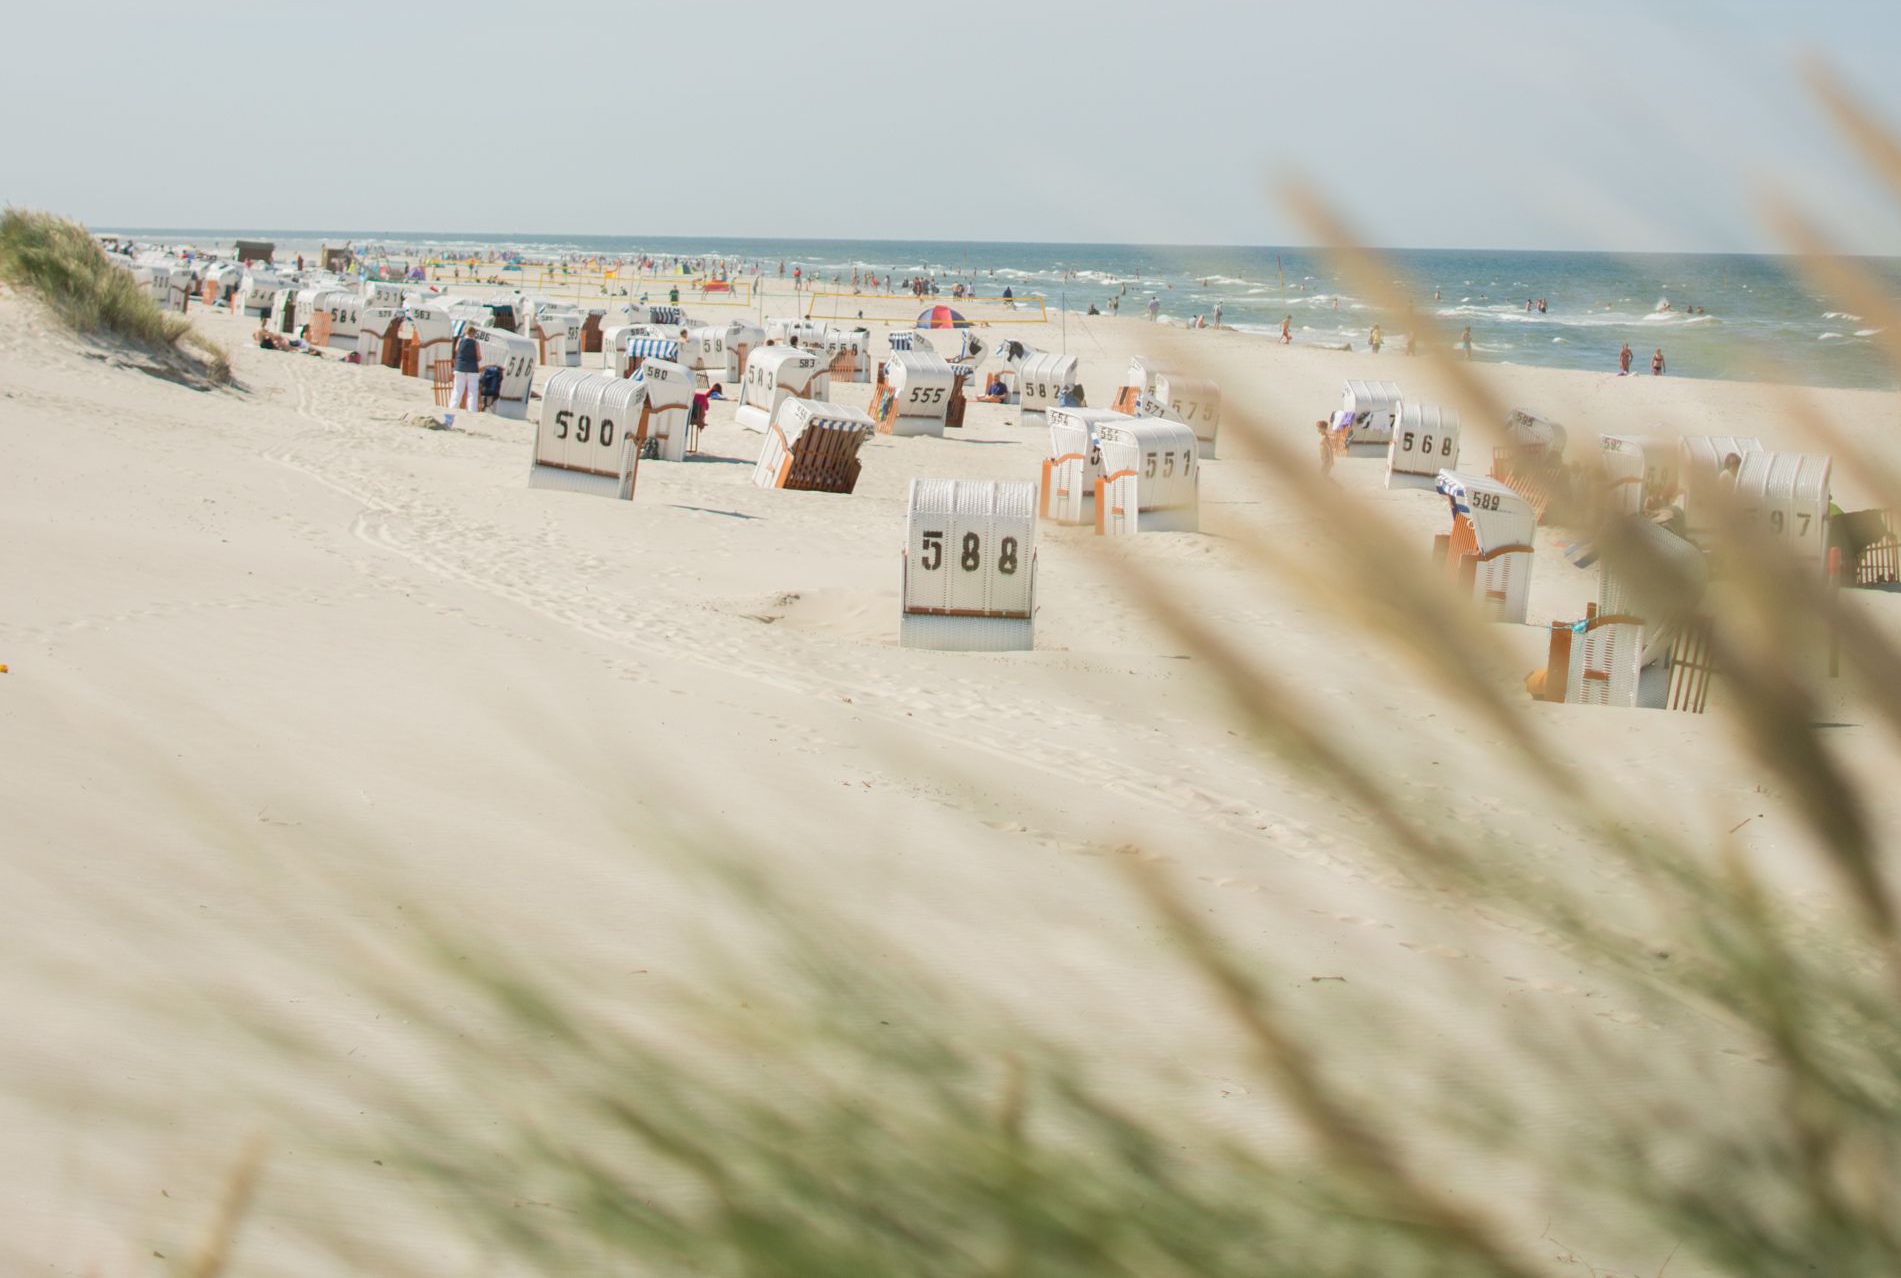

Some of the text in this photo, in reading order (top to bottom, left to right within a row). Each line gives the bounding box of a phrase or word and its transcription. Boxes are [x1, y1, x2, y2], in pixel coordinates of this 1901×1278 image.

[331, 308, 357, 324] 584
[414, 309, 431, 321] 563
[506, 356, 534, 378] 586
[799, 358, 816, 368] 583
[647, 367, 668, 381] 580
[909, 386, 946, 404] 555
[1025, 382, 1060, 399] 582
[1144, 400, 1165, 419] 571
[1172, 399, 1215, 422] 575
[555, 410, 614, 447] 590
[1402, 431, 1452, 457] 568
[1145, 449, 1192, 479] 551
[1472, 491, 1501, 511] 589
[921, 530, 1018, 575] 588
